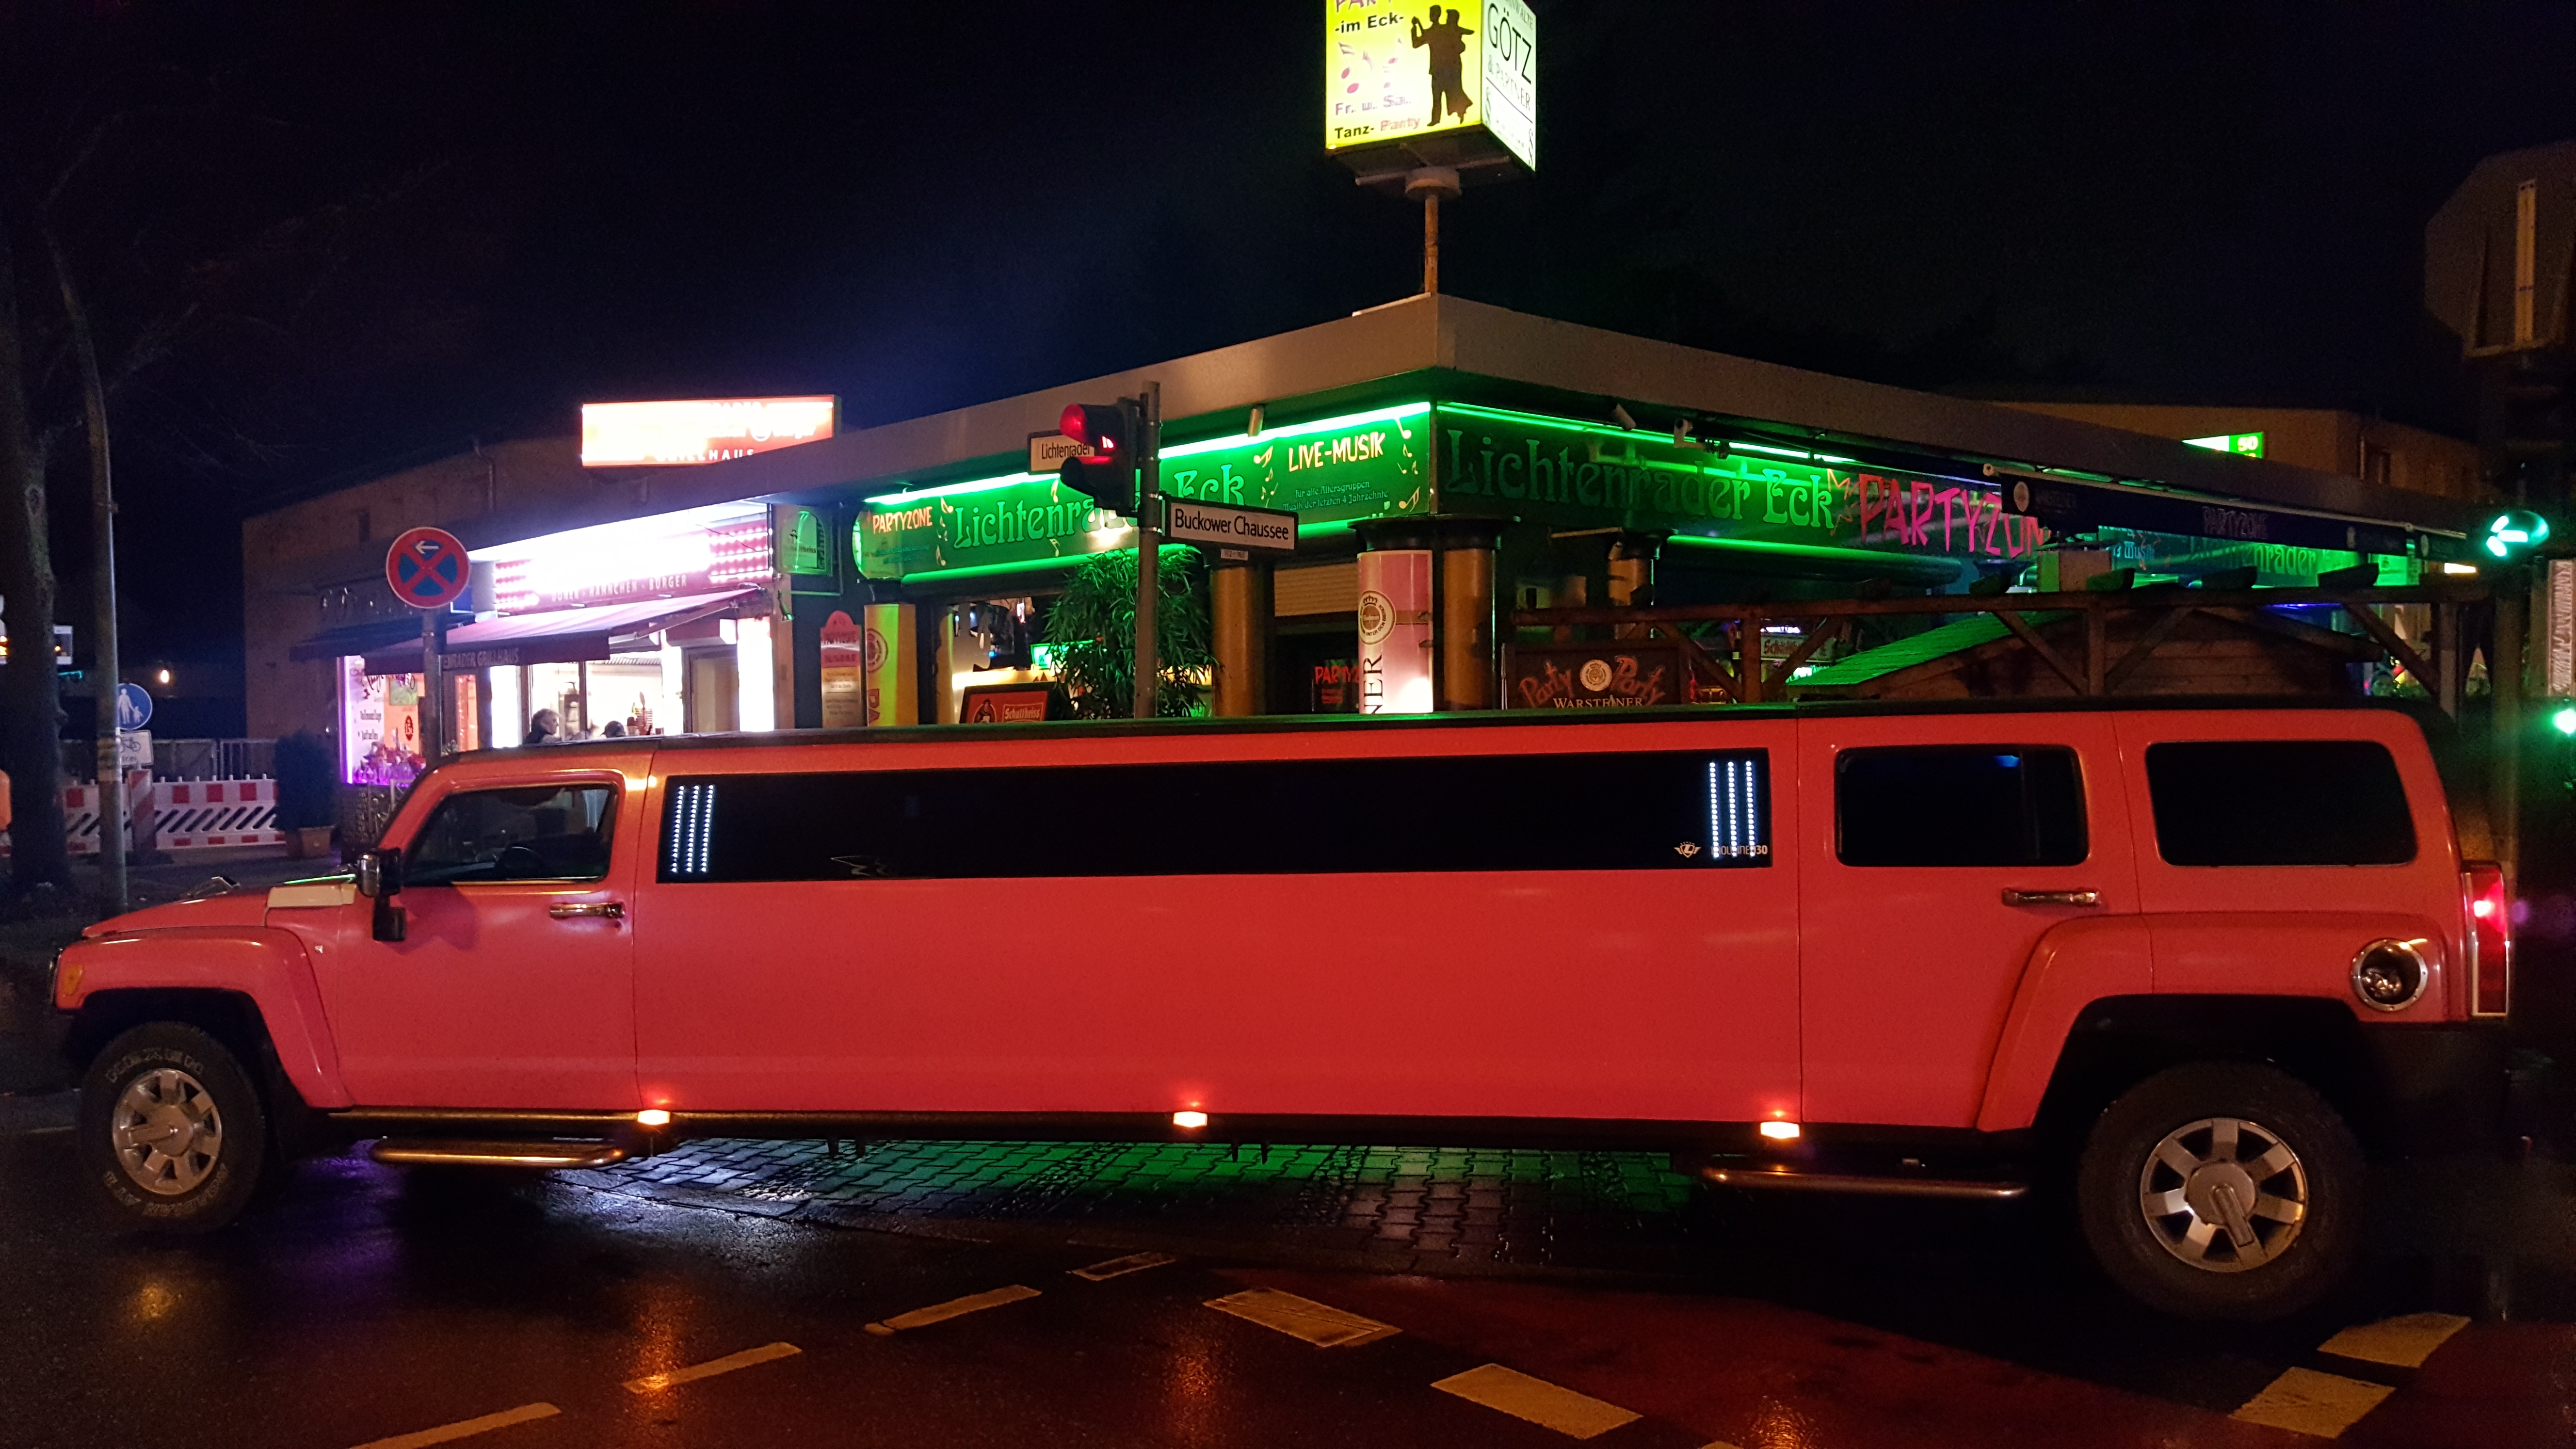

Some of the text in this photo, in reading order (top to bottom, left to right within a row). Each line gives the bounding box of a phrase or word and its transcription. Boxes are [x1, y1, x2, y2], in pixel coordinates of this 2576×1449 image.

[1335, 12, 1404, 33] -im Eck-
[1488, 2, 1532, 85] GÖTZ
[1335, 102, 1356, 116] Fr.
[1334, 117, 1421, 139] Tanz- Party
[1288, 431, 1386, 472] LIVE-MUSIK
[1295, 481, 1370, 498] für alle Altersgruppen
[1445, 429, 1835, 530] Lichtenrader Eck
[953, 464, 1245, 550] Lichtenra Eck
[1305, 500, 1317, 509] der
[1318, 497, 1341, 507] letzten
[1342, 495, 1347, 504] 4
[1348, 490, 1389, 504] Jahrzehnte
[873, 506, 933, 534] PARTYZONE
[1175, 508, 1289, 541] Buckower Chaussee
[1859, 473, 2044, 559] PARTYZON
[648, 574, 687, 591] BURGER
[1004, 706, 1041, 720] Schultheiss
[1553, 697, 1643, 708] WARSTENER
